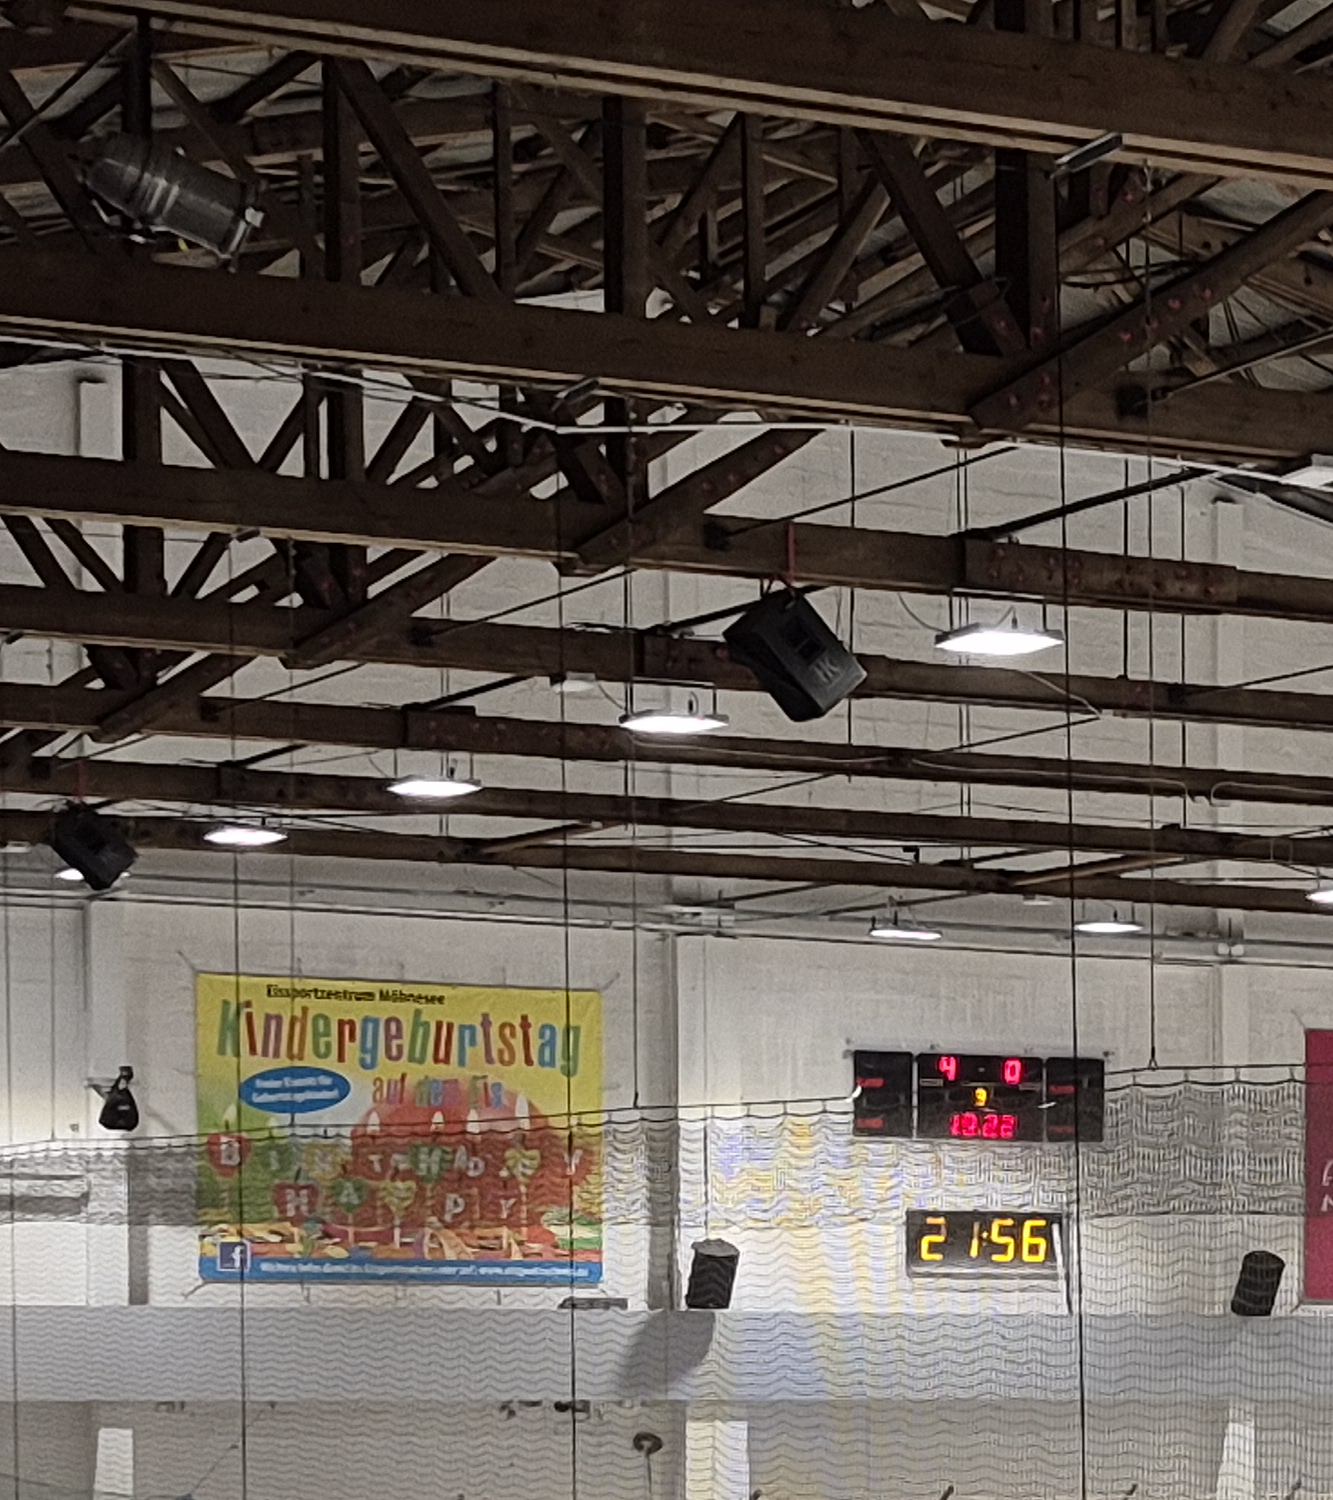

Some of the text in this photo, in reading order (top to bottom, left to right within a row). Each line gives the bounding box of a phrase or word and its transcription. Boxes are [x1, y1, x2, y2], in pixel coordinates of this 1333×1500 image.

[215, 999, 583, 1078] Kindergeburtstag
[373, 1072, 407, 1105] auf
[1004, 1059, 1022, 1085] 0
